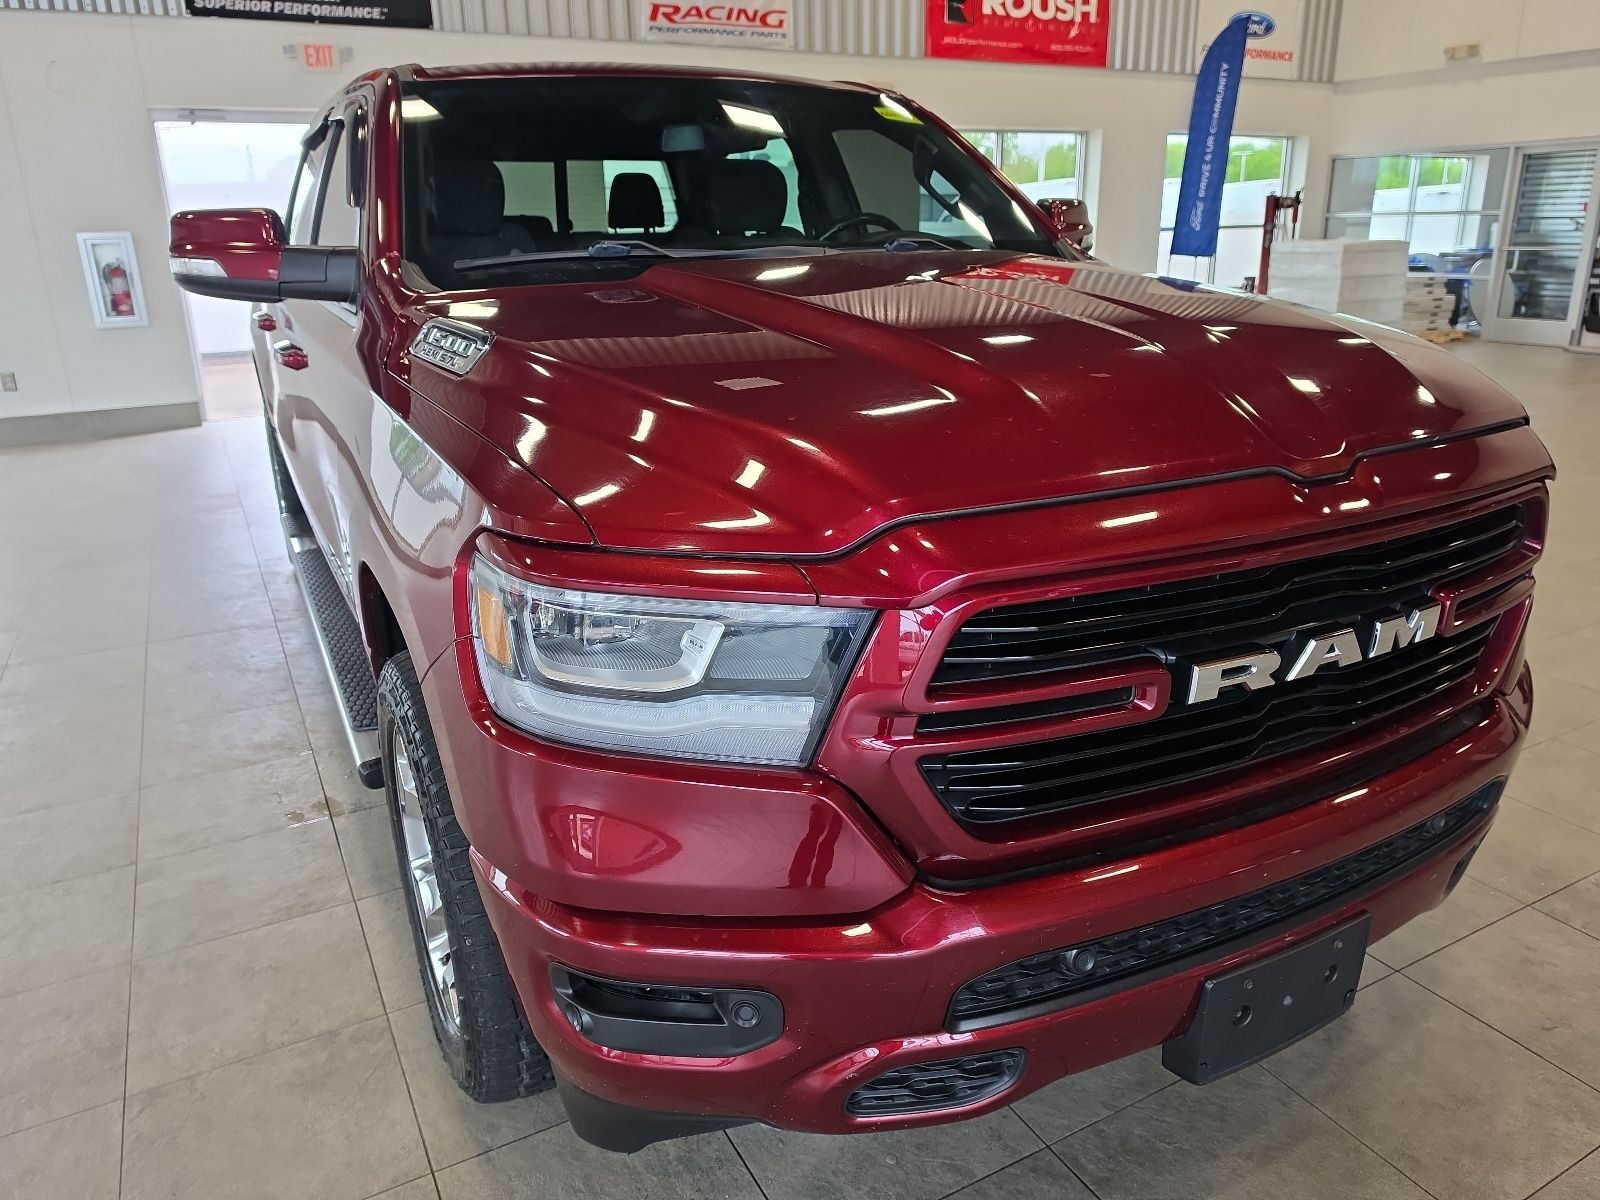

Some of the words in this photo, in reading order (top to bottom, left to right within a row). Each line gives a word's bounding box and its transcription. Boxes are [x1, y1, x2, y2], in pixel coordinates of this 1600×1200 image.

[194, 0, 272, 13] SUPERIOR
[649, 3, 788, 29] RACING
[982, 0, 1099, 23] ROUSH
[649, 26, 746, 38] PERFORMANCE
[750, 31, 788, 40] PARTS
[304, 44, 335, 68] EXIT
[1189, 200, 1206, 232] Ford
[1199, 162, 1212, 198] DRIVE
[1209, 61, 1231, 134] COMMUNITY
[421, 344, 442, 361] HEMI
[426, 327, 476, 357] 1500
[1187, 602, 1441, 704] RAM
